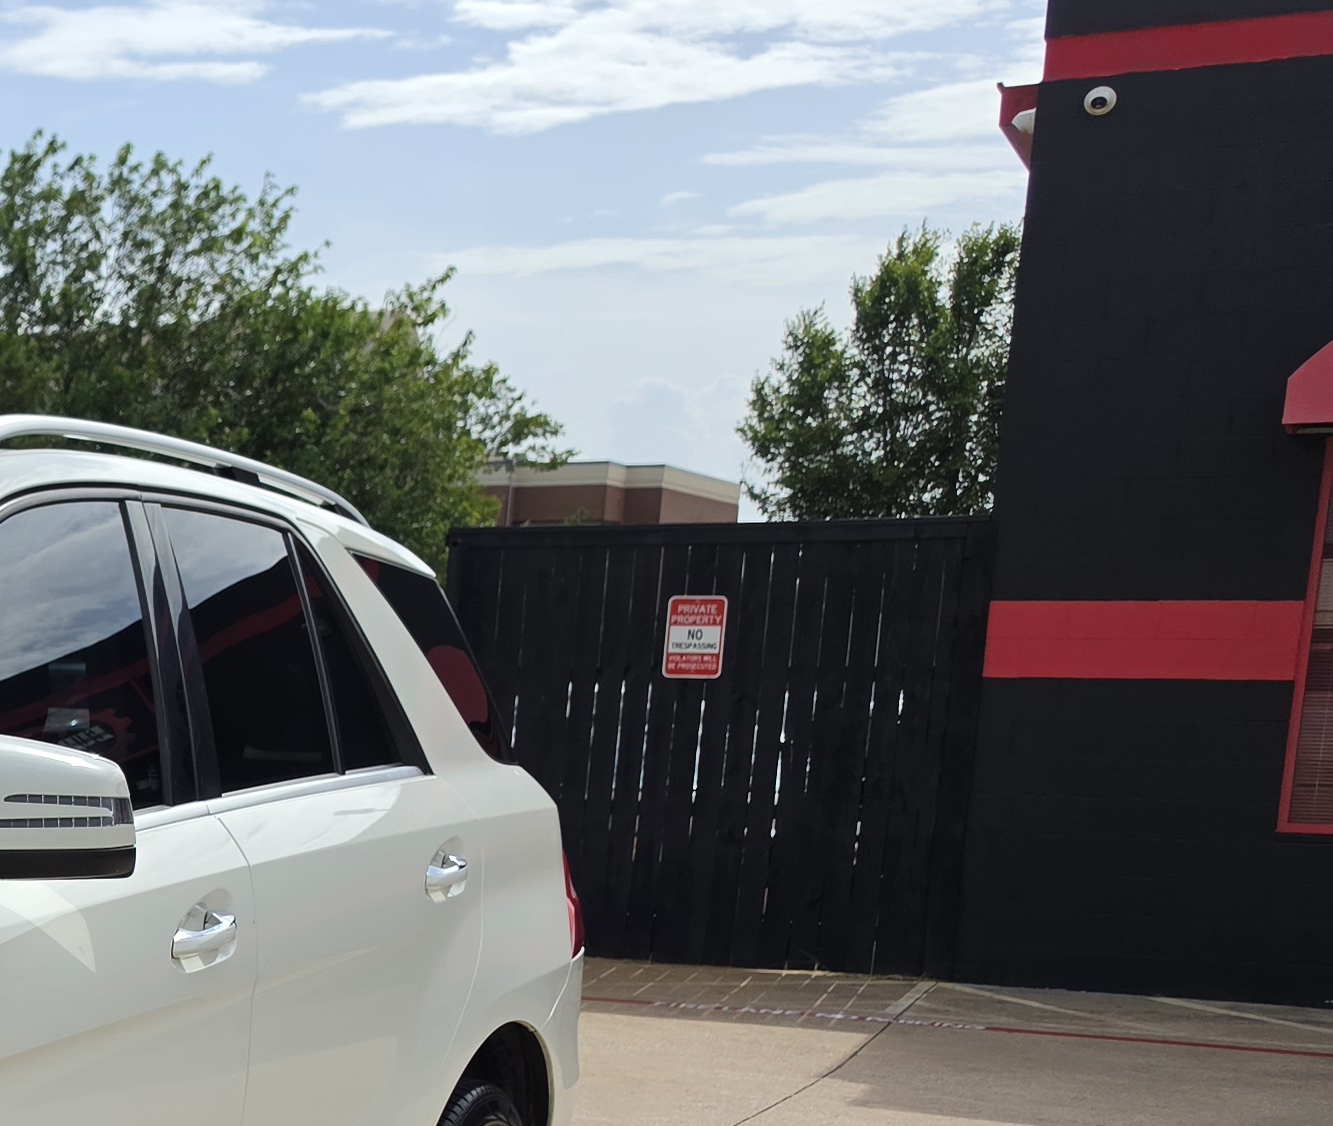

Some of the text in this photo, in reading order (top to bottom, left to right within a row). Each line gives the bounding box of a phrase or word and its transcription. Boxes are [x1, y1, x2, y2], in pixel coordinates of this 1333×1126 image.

[677, 603, 718, 614] PRIVATE
[671, 614, 722, 624] PROPERTY
[687, 628, 703, 641] NO
